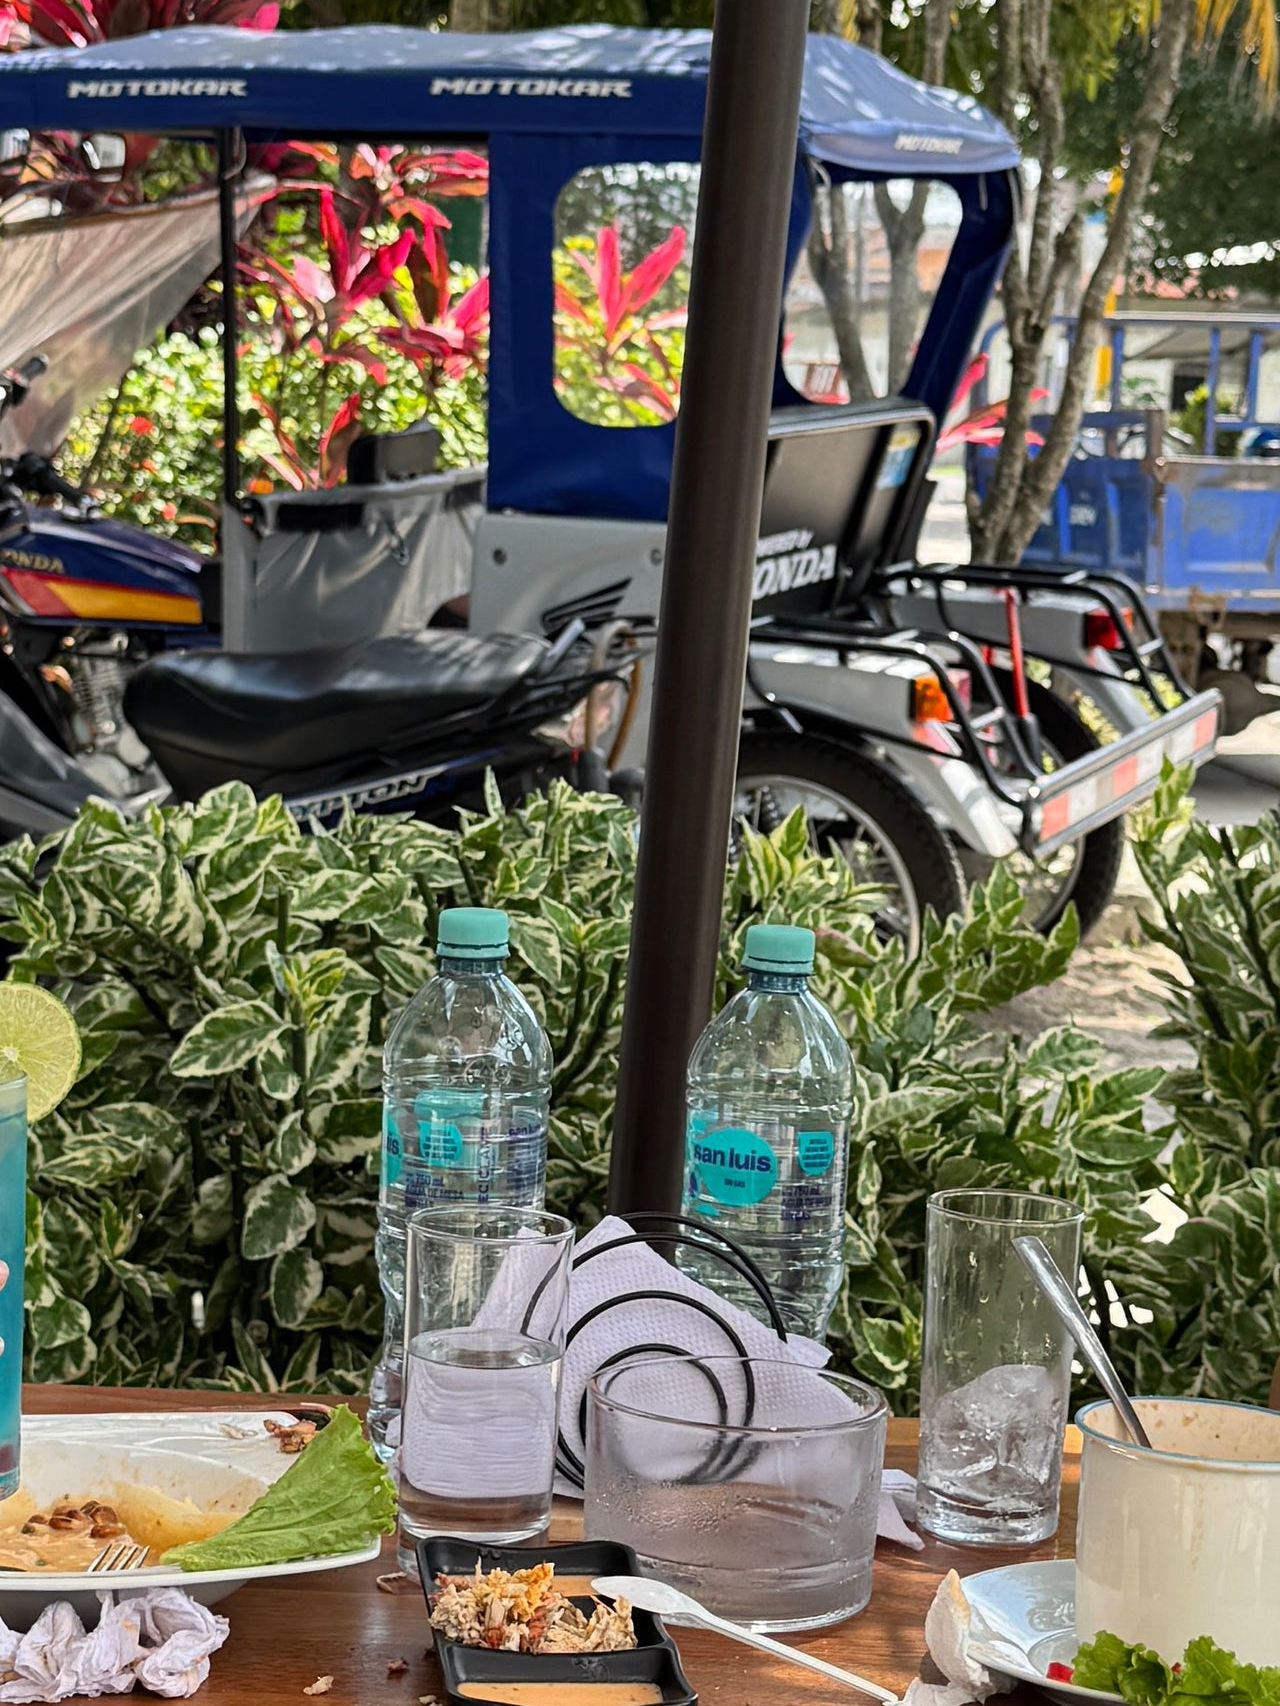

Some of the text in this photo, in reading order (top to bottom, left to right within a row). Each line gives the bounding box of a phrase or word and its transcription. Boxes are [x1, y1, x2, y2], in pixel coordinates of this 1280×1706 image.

[68, 78, 247, 98] MOTOKAR
[431, 77, 632, 98] MOTOKAR
[752, 545, 837, 601] ONDA
[694, 1144, 771, 1172] san luis
